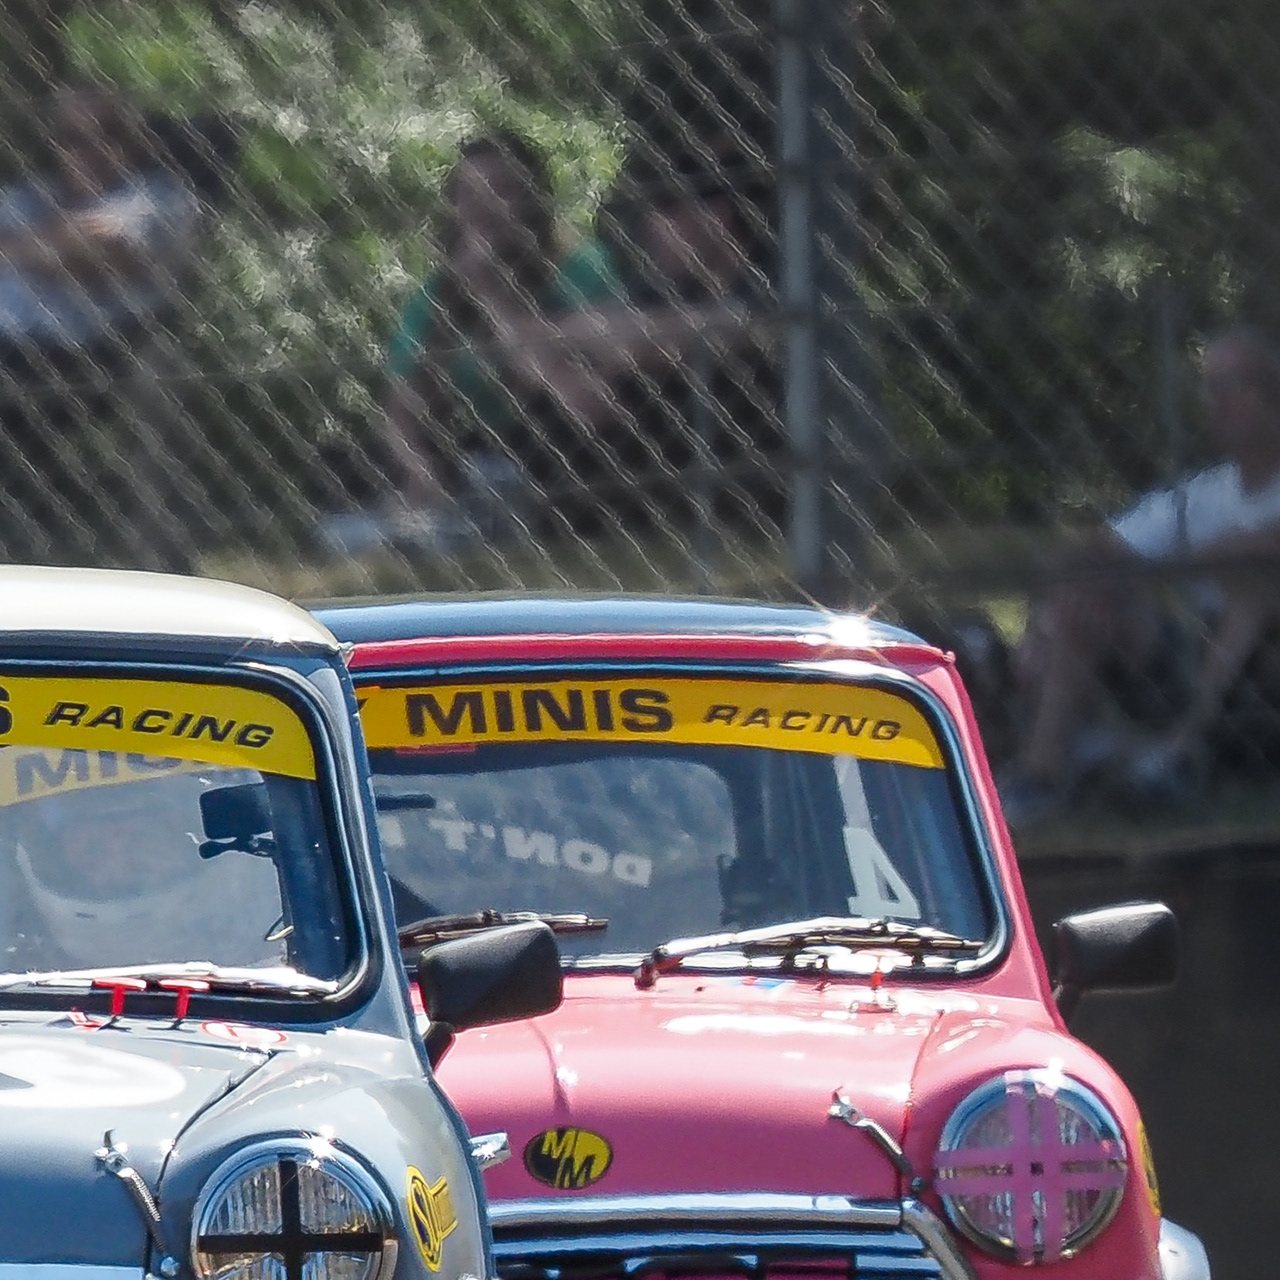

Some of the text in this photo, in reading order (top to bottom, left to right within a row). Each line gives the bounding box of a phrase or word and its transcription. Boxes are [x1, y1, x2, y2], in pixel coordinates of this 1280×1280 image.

[44, 700, 275, 750] RACING
[404, 688, 674, 738] MINIS
[700, 704, 902, 742] RACING
